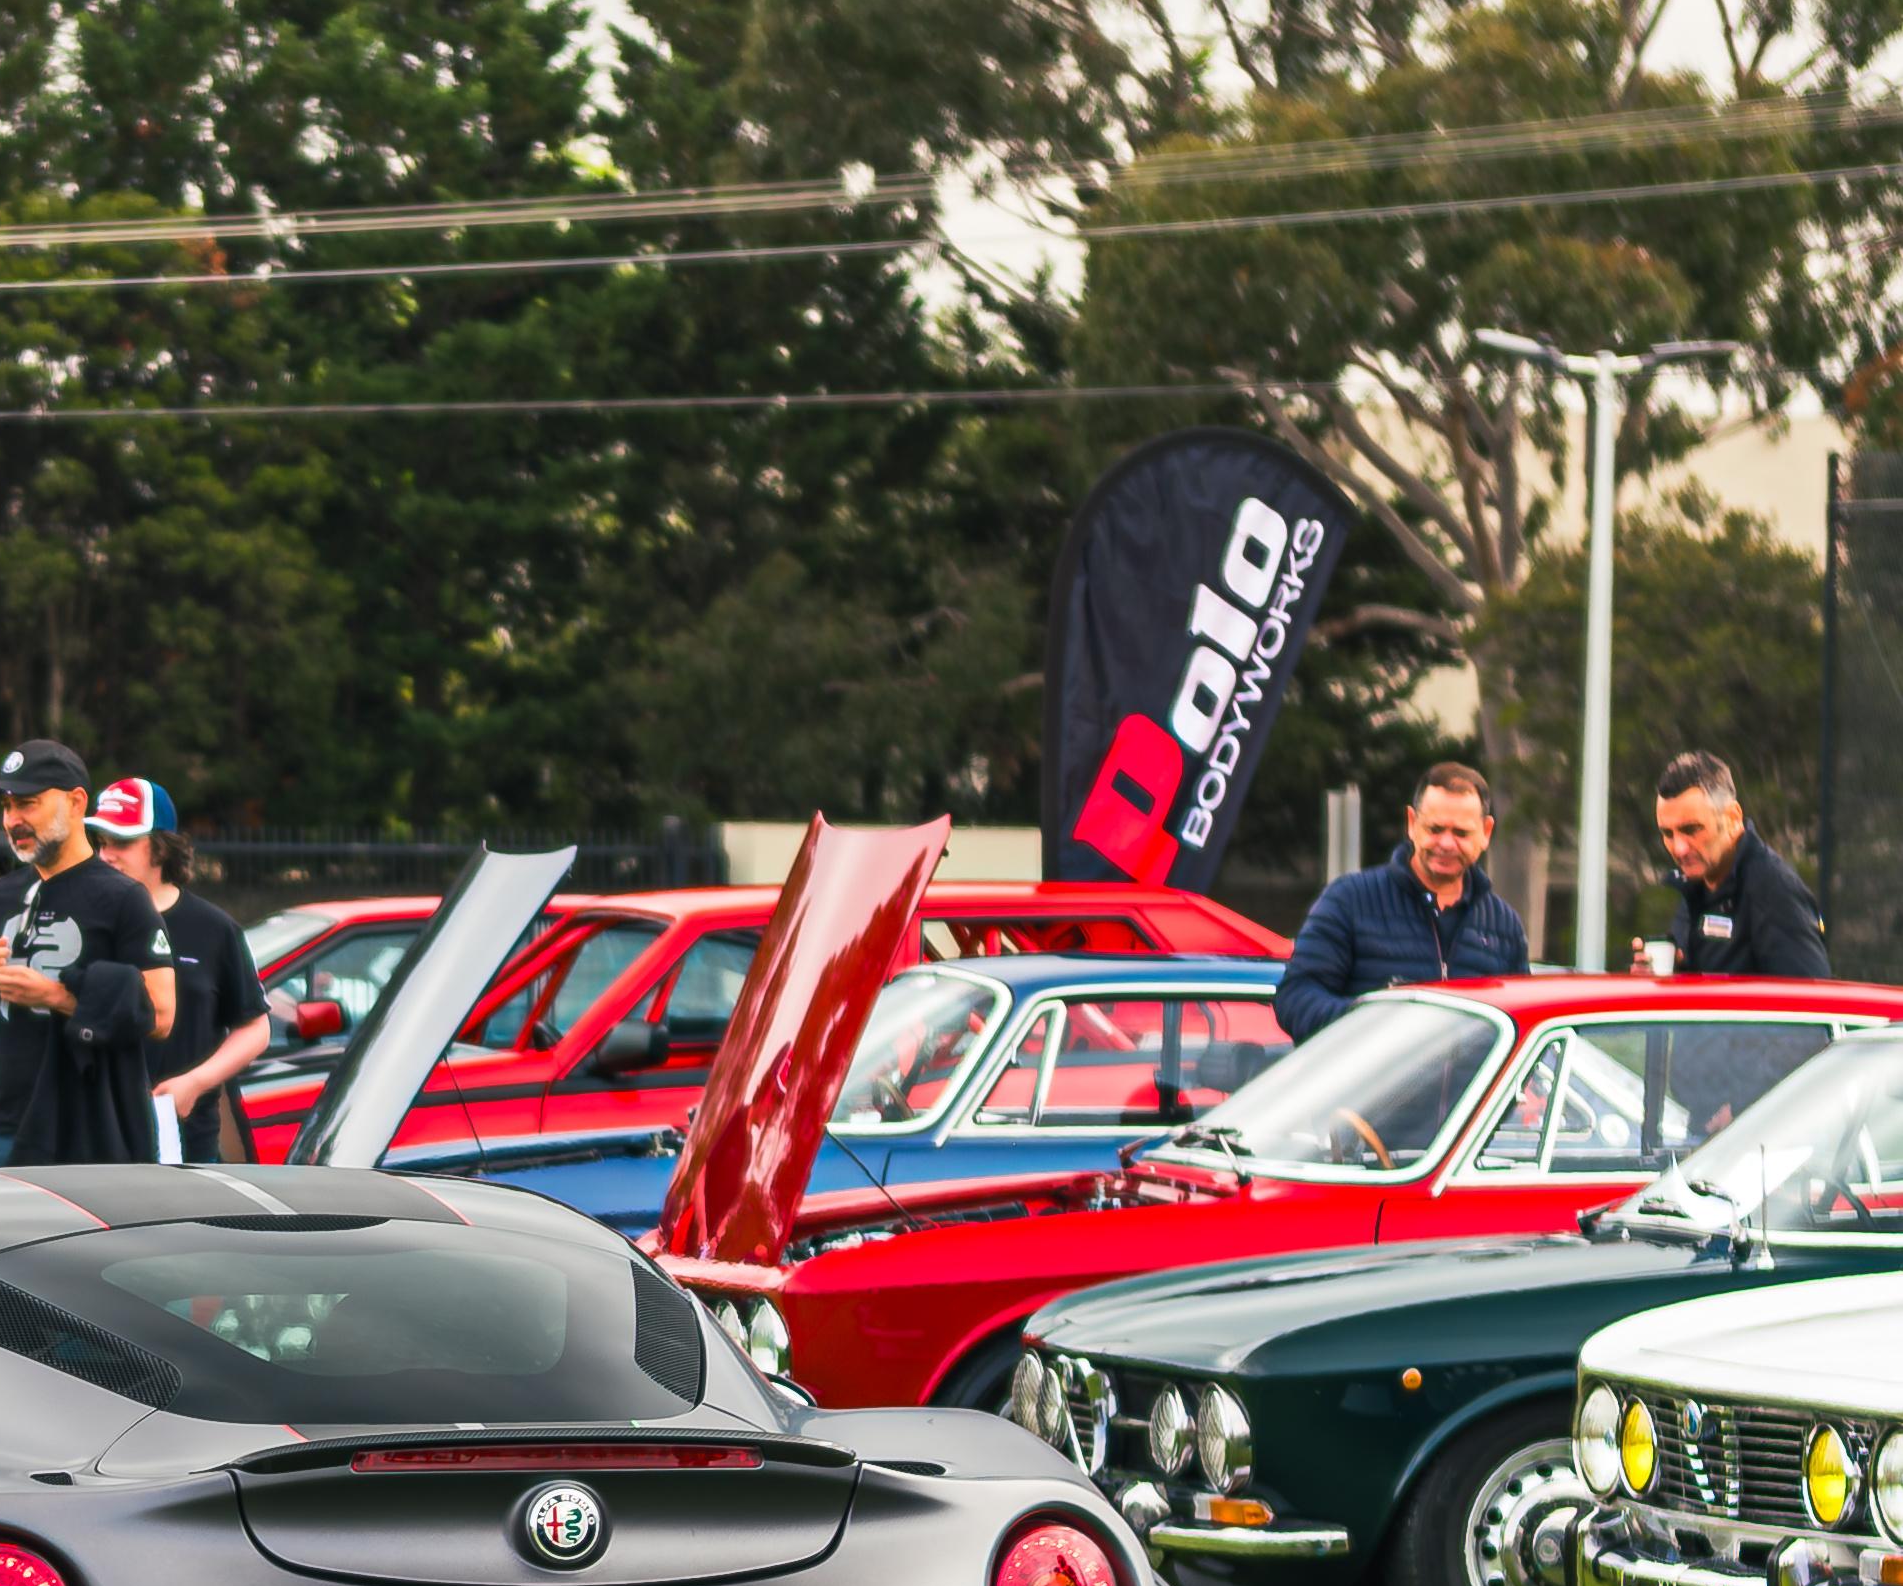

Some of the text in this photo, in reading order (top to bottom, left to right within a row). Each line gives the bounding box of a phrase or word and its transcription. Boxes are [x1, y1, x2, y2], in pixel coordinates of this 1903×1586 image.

[1181, 518, 1325, 848] BODYWORKS
[537, 1494, 595, 1526] ALFA ROMO
